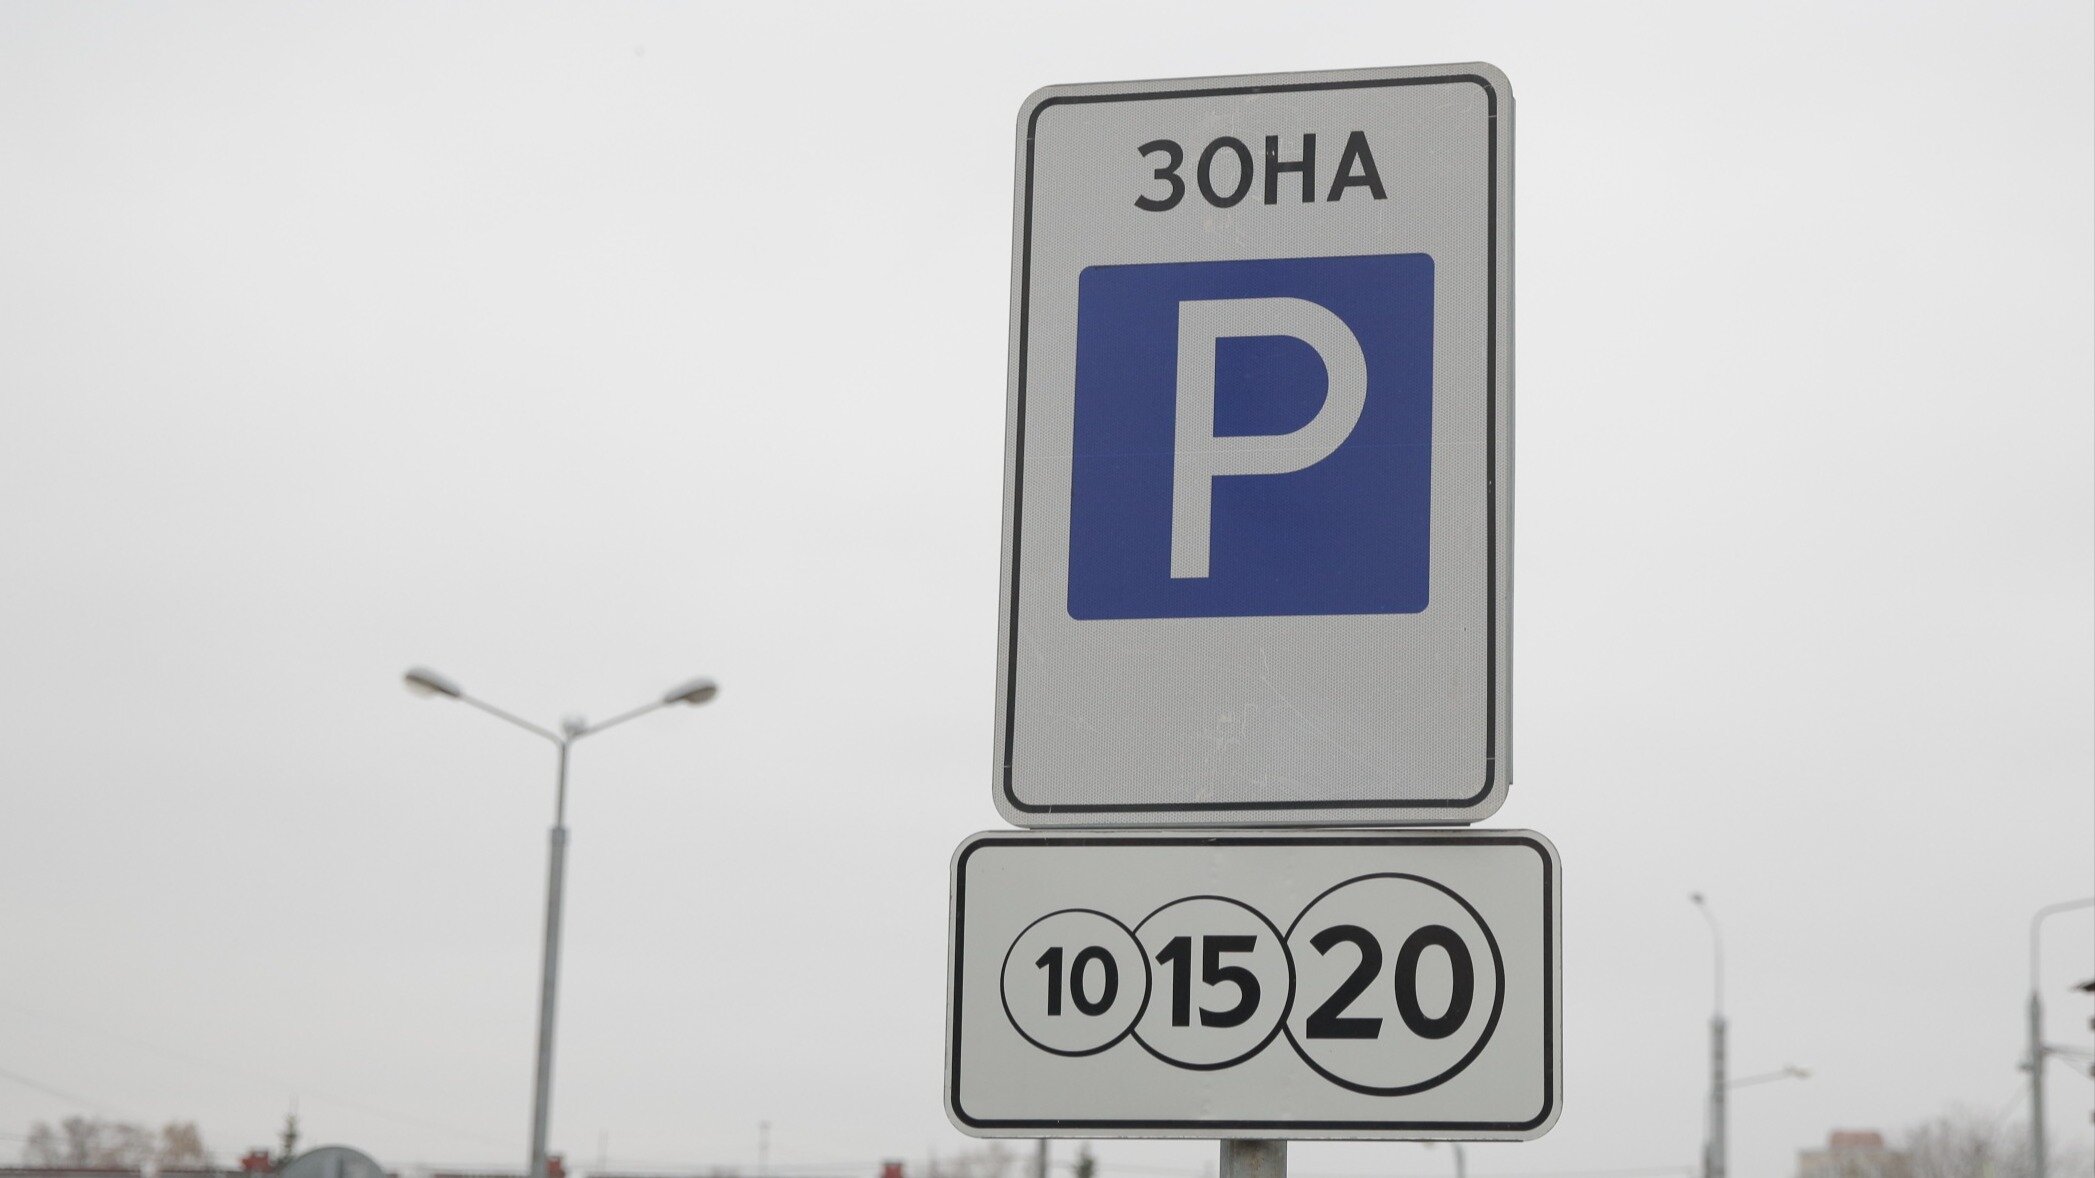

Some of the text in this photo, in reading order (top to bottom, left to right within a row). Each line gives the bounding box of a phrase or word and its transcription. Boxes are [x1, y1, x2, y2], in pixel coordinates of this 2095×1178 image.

[1134, 130, 1388, 212] ЗОНА
[1170, 296, 1368, 580] P
[1035, 924, 1475, 1040] 10 15 20
